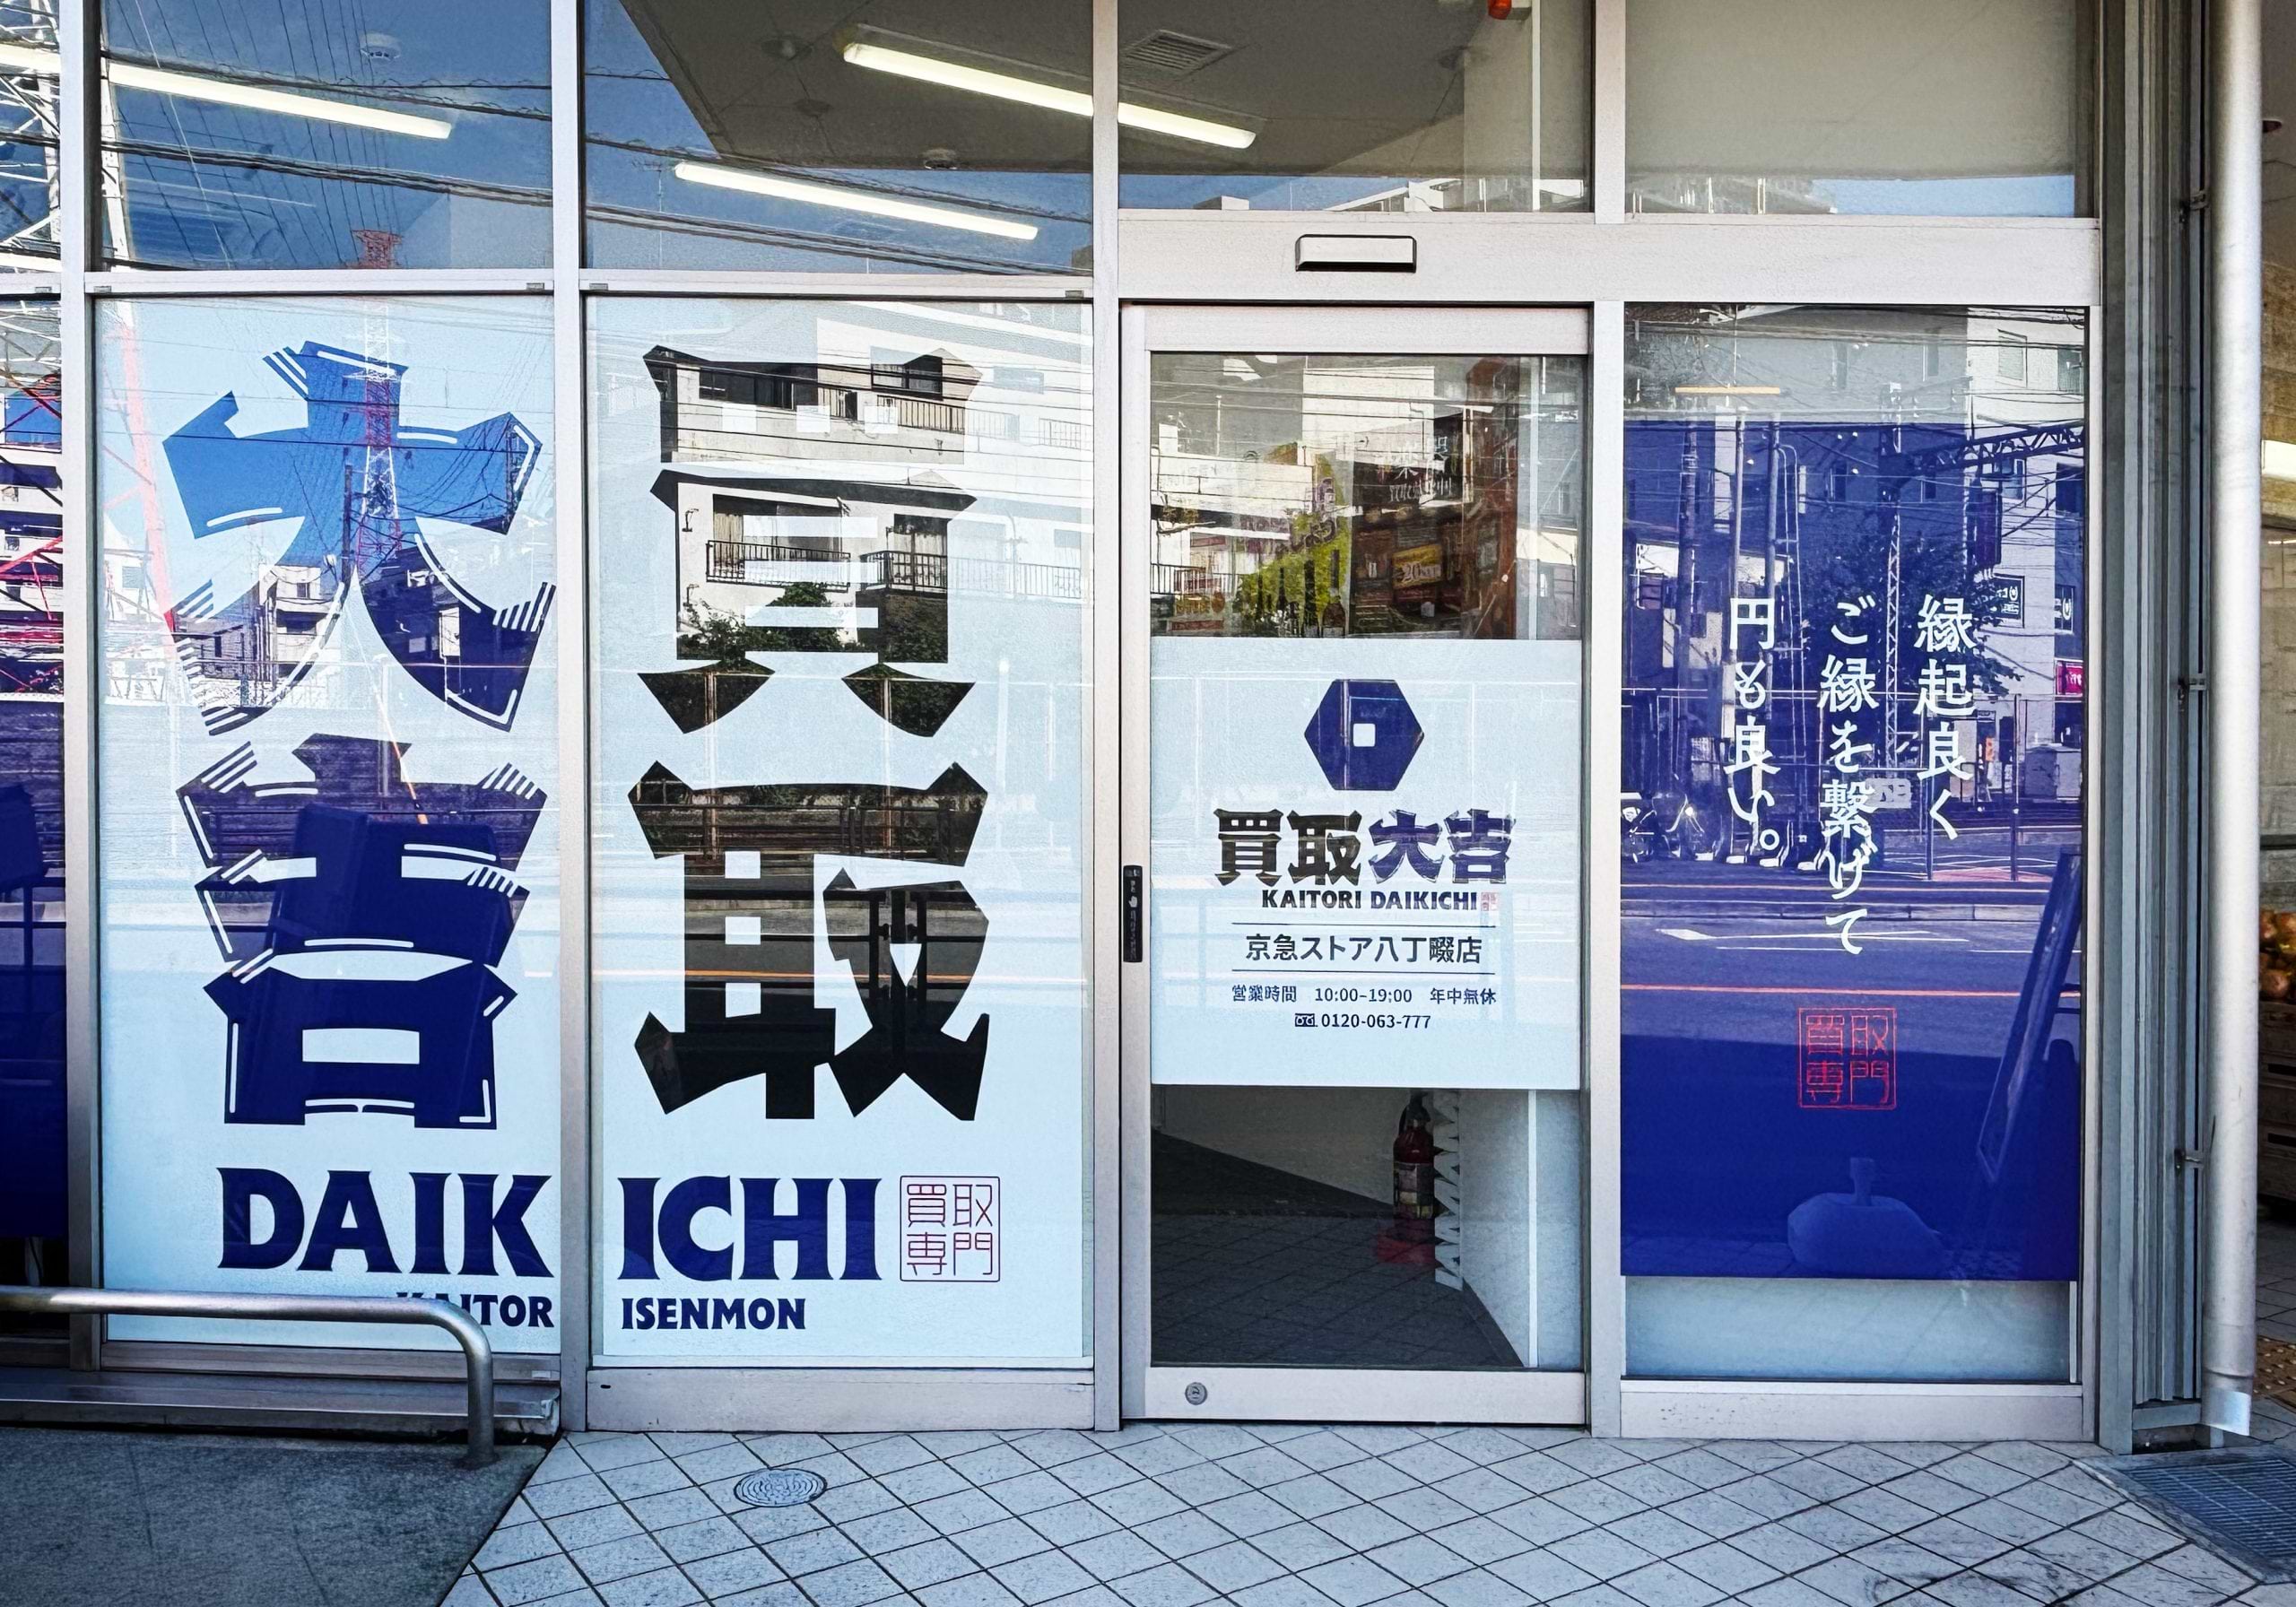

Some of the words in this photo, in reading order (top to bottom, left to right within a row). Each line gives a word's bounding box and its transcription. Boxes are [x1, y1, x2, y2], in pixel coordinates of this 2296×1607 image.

[162, 340, 556, 1130] 大吉
[628, 344, 989, 1122] 買取
[1723, 596, 1782, 851] 円も良い。
[1910, 594, 1977, 841] 縁起良く
[1816, 594, 1881, 955] ご縁を繋げて
[1213, 808, 1517, 886] 買取大吉
[1261, 889, 1362, 909] KAITORI
[1370, 890, 1478, 911] DAIKICHI
[1245, 933, 1483, 964] 京急ストア八丁畷店
[1231, 985, 1298, 1003] 営業時間
[1315, 987, 1413, 1003] 10:00-19:00
[1430, 987, 1497, 1005] 年中無休
[1321, 1013, 1432, 1029] 0120-063-777
[396, 1291, 554, 1328] ITOR
[622, 1297, 806, 1330] ISENMON
